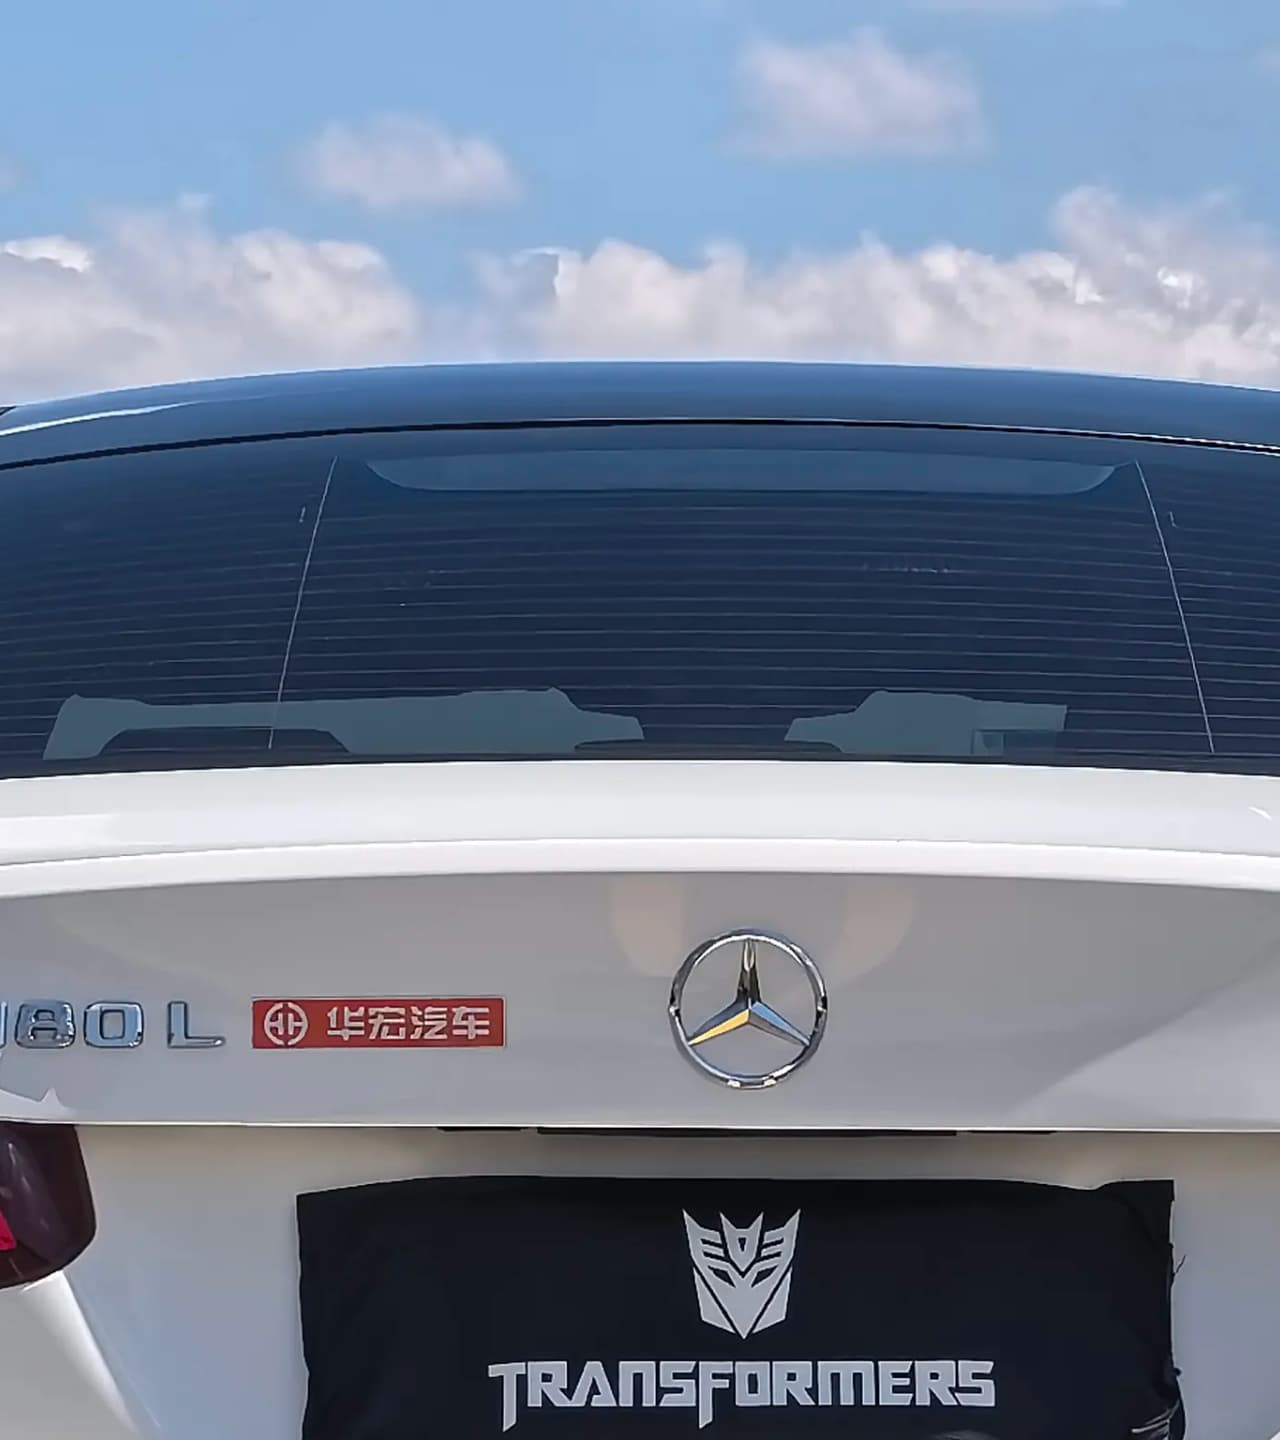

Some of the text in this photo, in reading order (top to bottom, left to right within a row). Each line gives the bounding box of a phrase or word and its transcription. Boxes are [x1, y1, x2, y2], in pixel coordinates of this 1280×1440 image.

[326, 1006, 490, 1041] 华宏汽车
[488, 1360, 997, 1432] TRANSFORMERS
